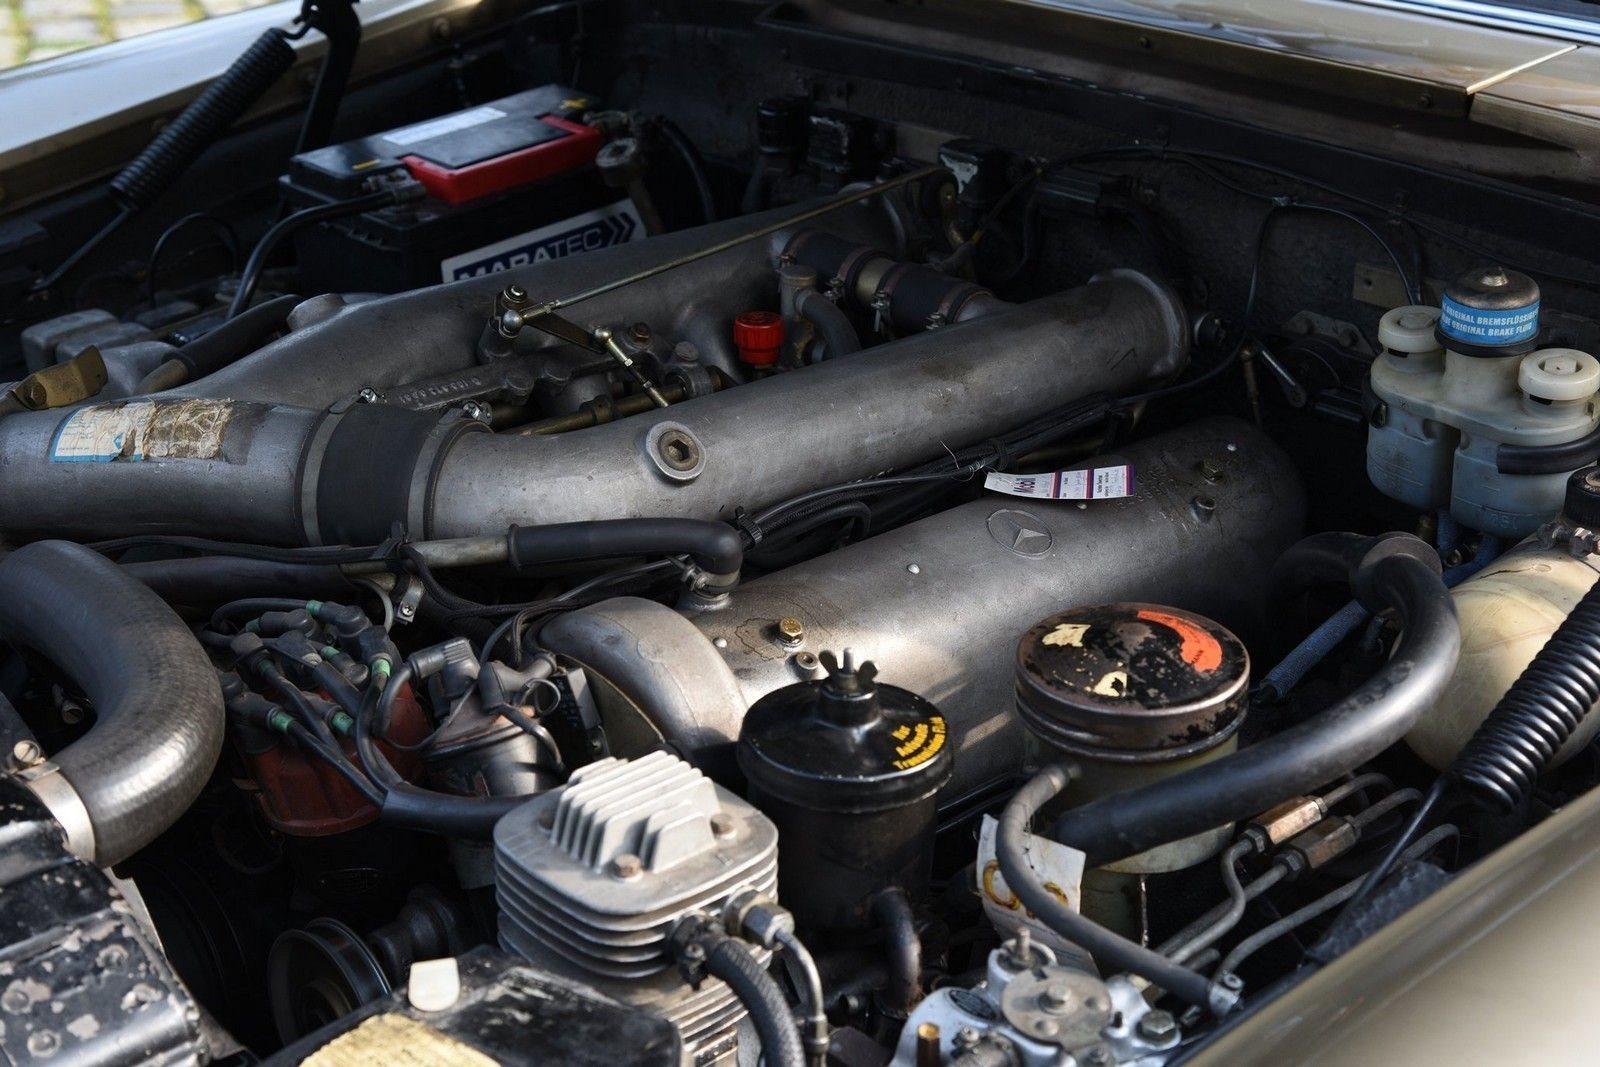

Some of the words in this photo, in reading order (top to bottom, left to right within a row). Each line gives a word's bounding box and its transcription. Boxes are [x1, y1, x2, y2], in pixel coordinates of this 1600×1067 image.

[1446, 305, 1475, 324] ORIGINAL
[1451, 320, 1486, 336] ORIGINAL
[1488, 328, 1515, 337] BRAKE
[1516, 322, 1533, 334] FLUID
[892, 733, 946, 770] Transmission
[929, 716, 946, 734] Fluid
